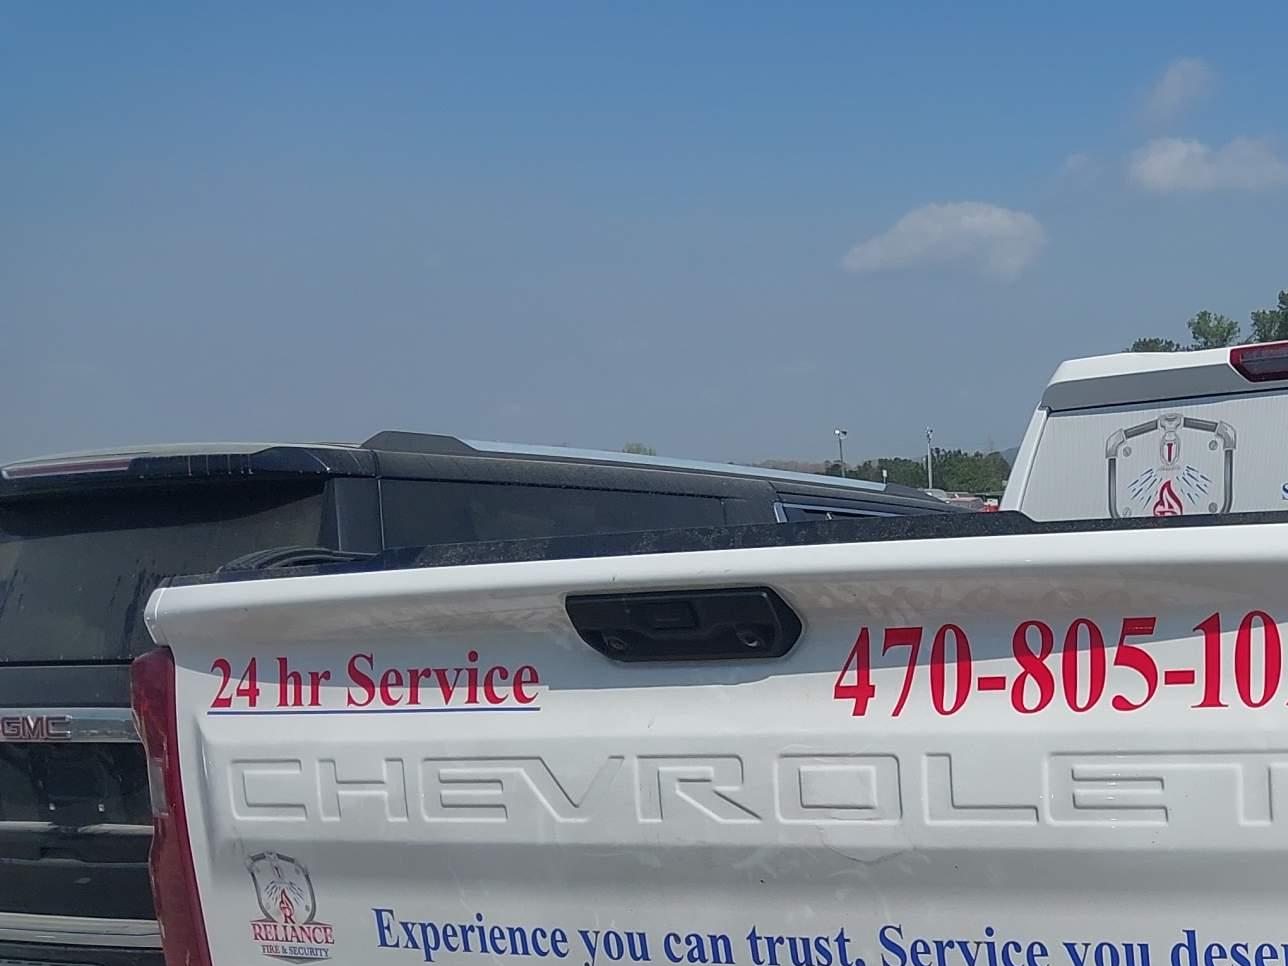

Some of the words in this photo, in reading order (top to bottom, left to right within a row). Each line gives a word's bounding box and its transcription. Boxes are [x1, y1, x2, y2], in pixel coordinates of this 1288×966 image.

[210, 656, 260, 708] 24
[276, 656, 331, 707] hr
[347, 650, 540, 707] Service
[2, 716, 72, 739] GMC
[251, 923, 335, 944] RELIANCE
[372, 908, 569, 962] Experience
[663, 932, 735, 965] can
[262, 944, 280, 954] FIRE
[289, 946, 329, 957] SECURITY
